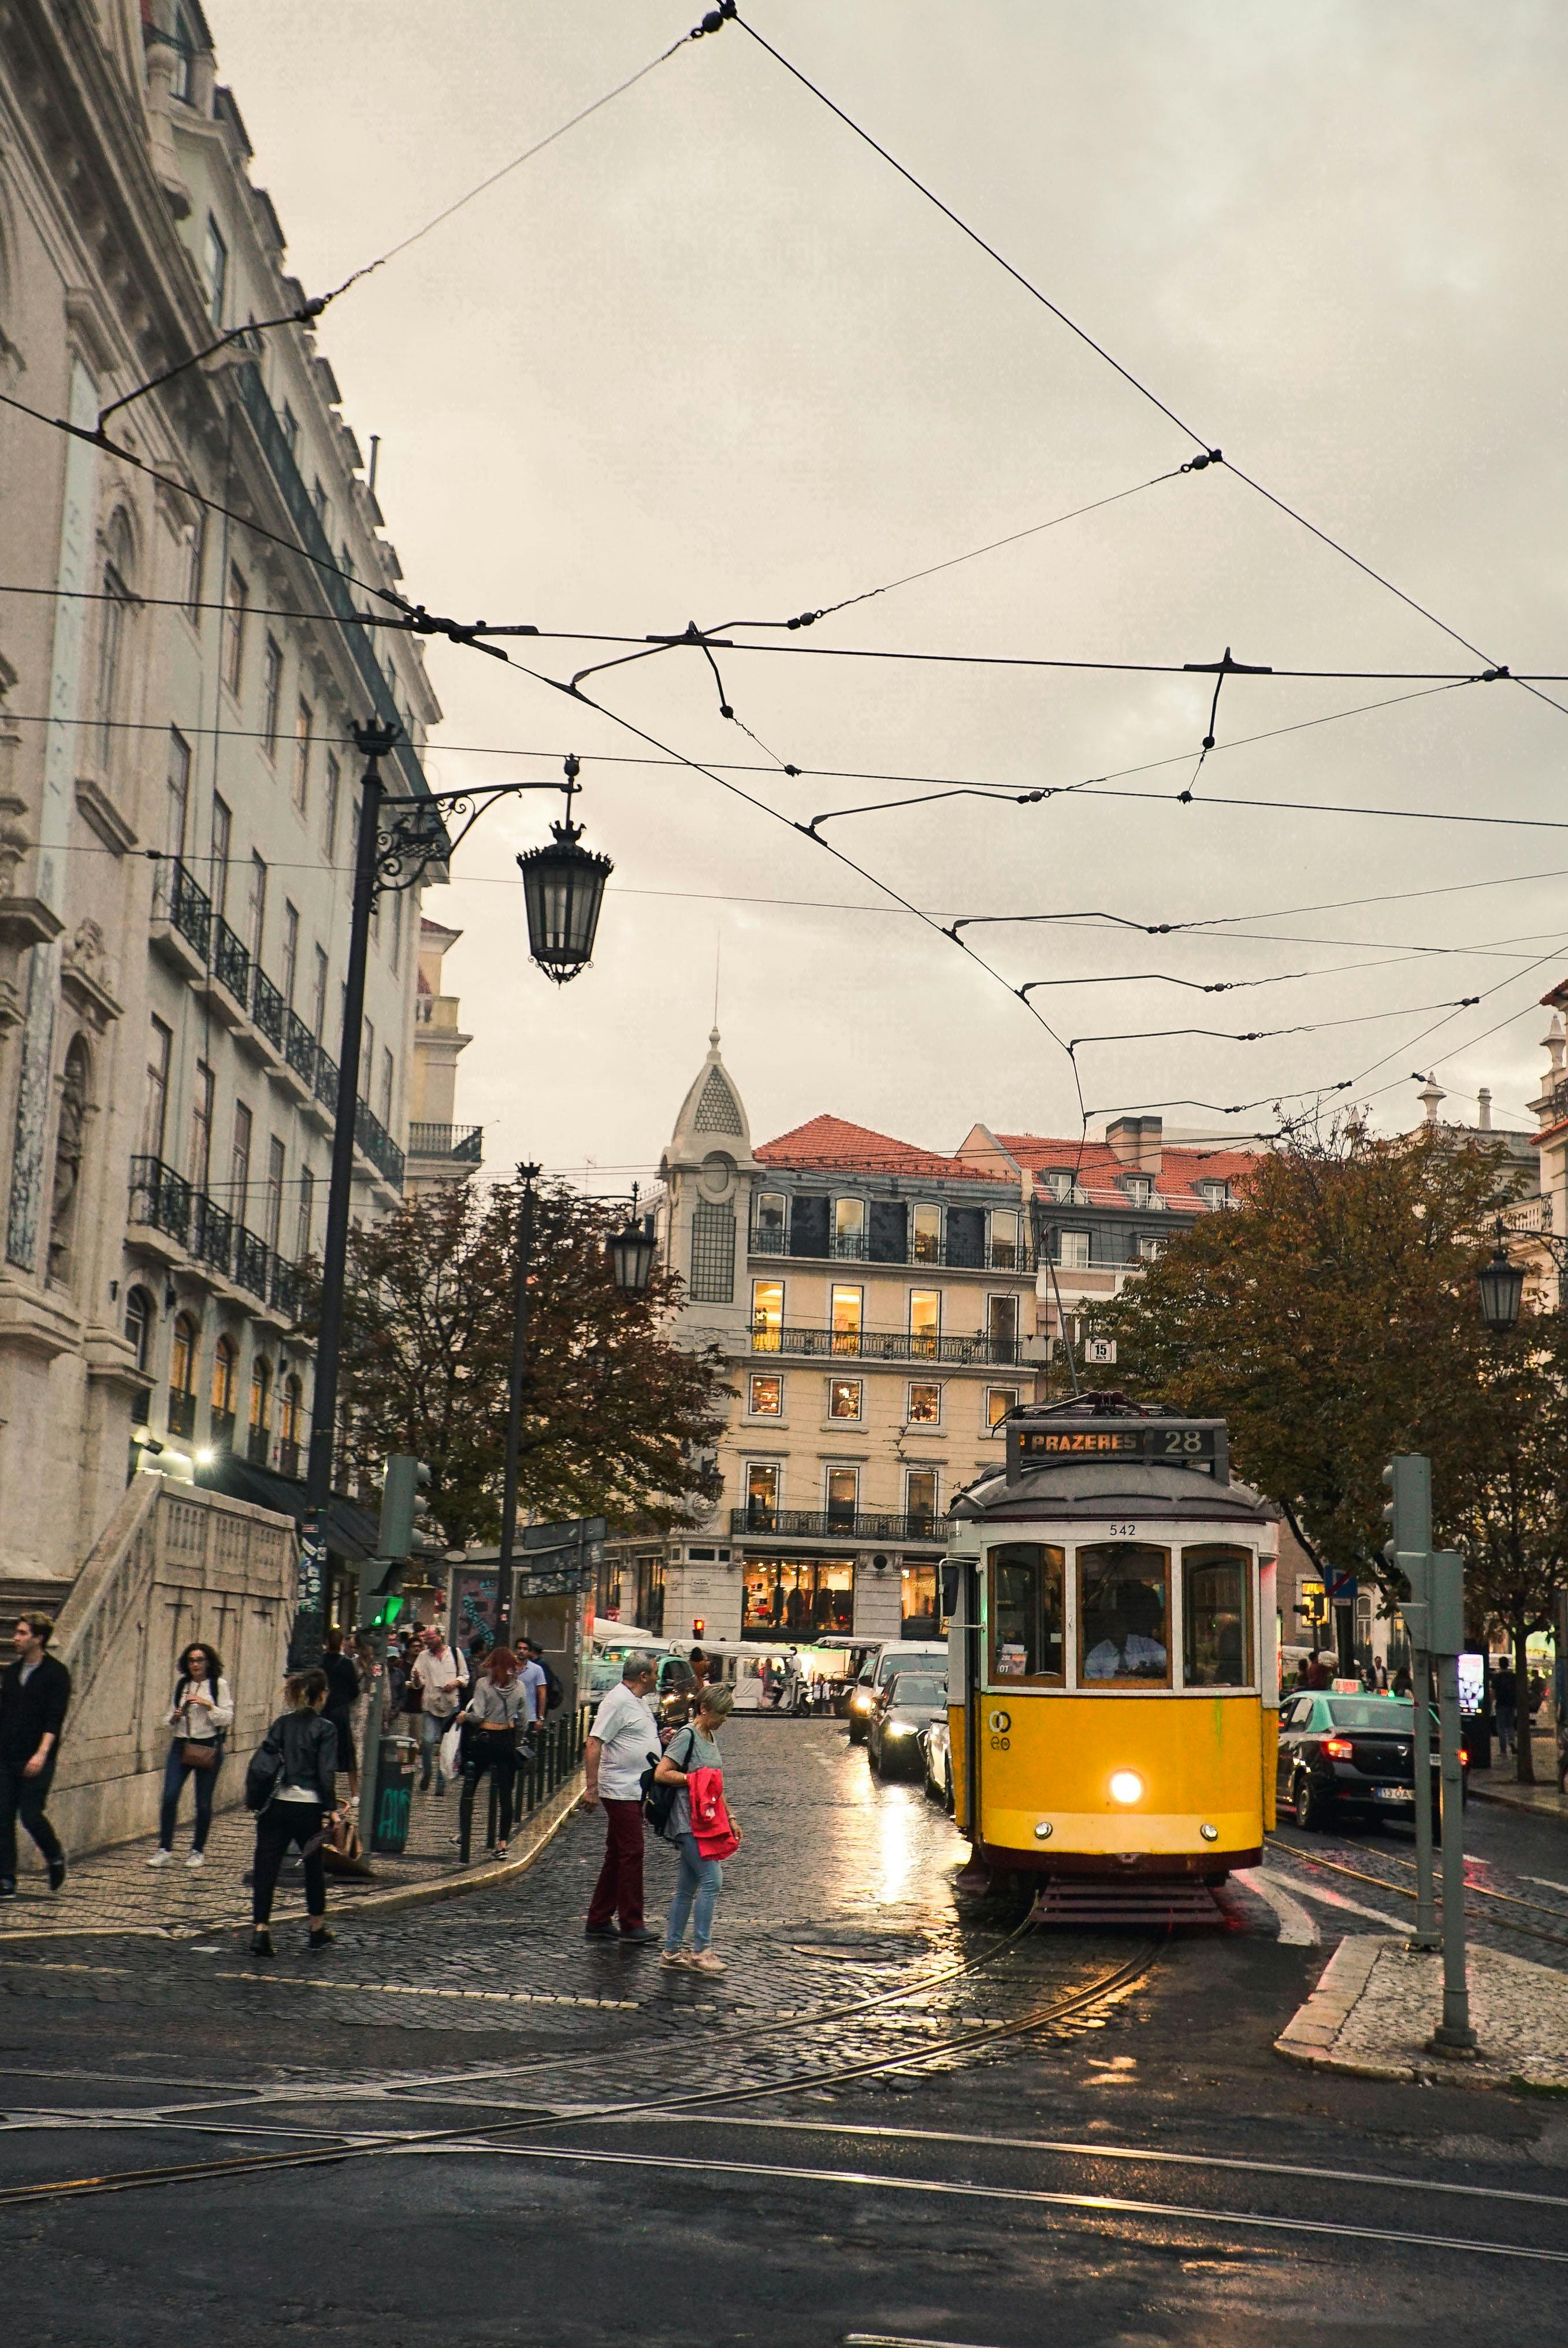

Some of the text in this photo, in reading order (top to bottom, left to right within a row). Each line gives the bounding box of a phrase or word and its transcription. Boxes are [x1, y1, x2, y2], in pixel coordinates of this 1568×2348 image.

[1095, 1344, 1107, 1356] 15
[1032, 1433, 1137, 1451] PRAZERES
[1165, 1430, 1202, 1453] 28
[1109, 1524, 1136, 1535] 542
